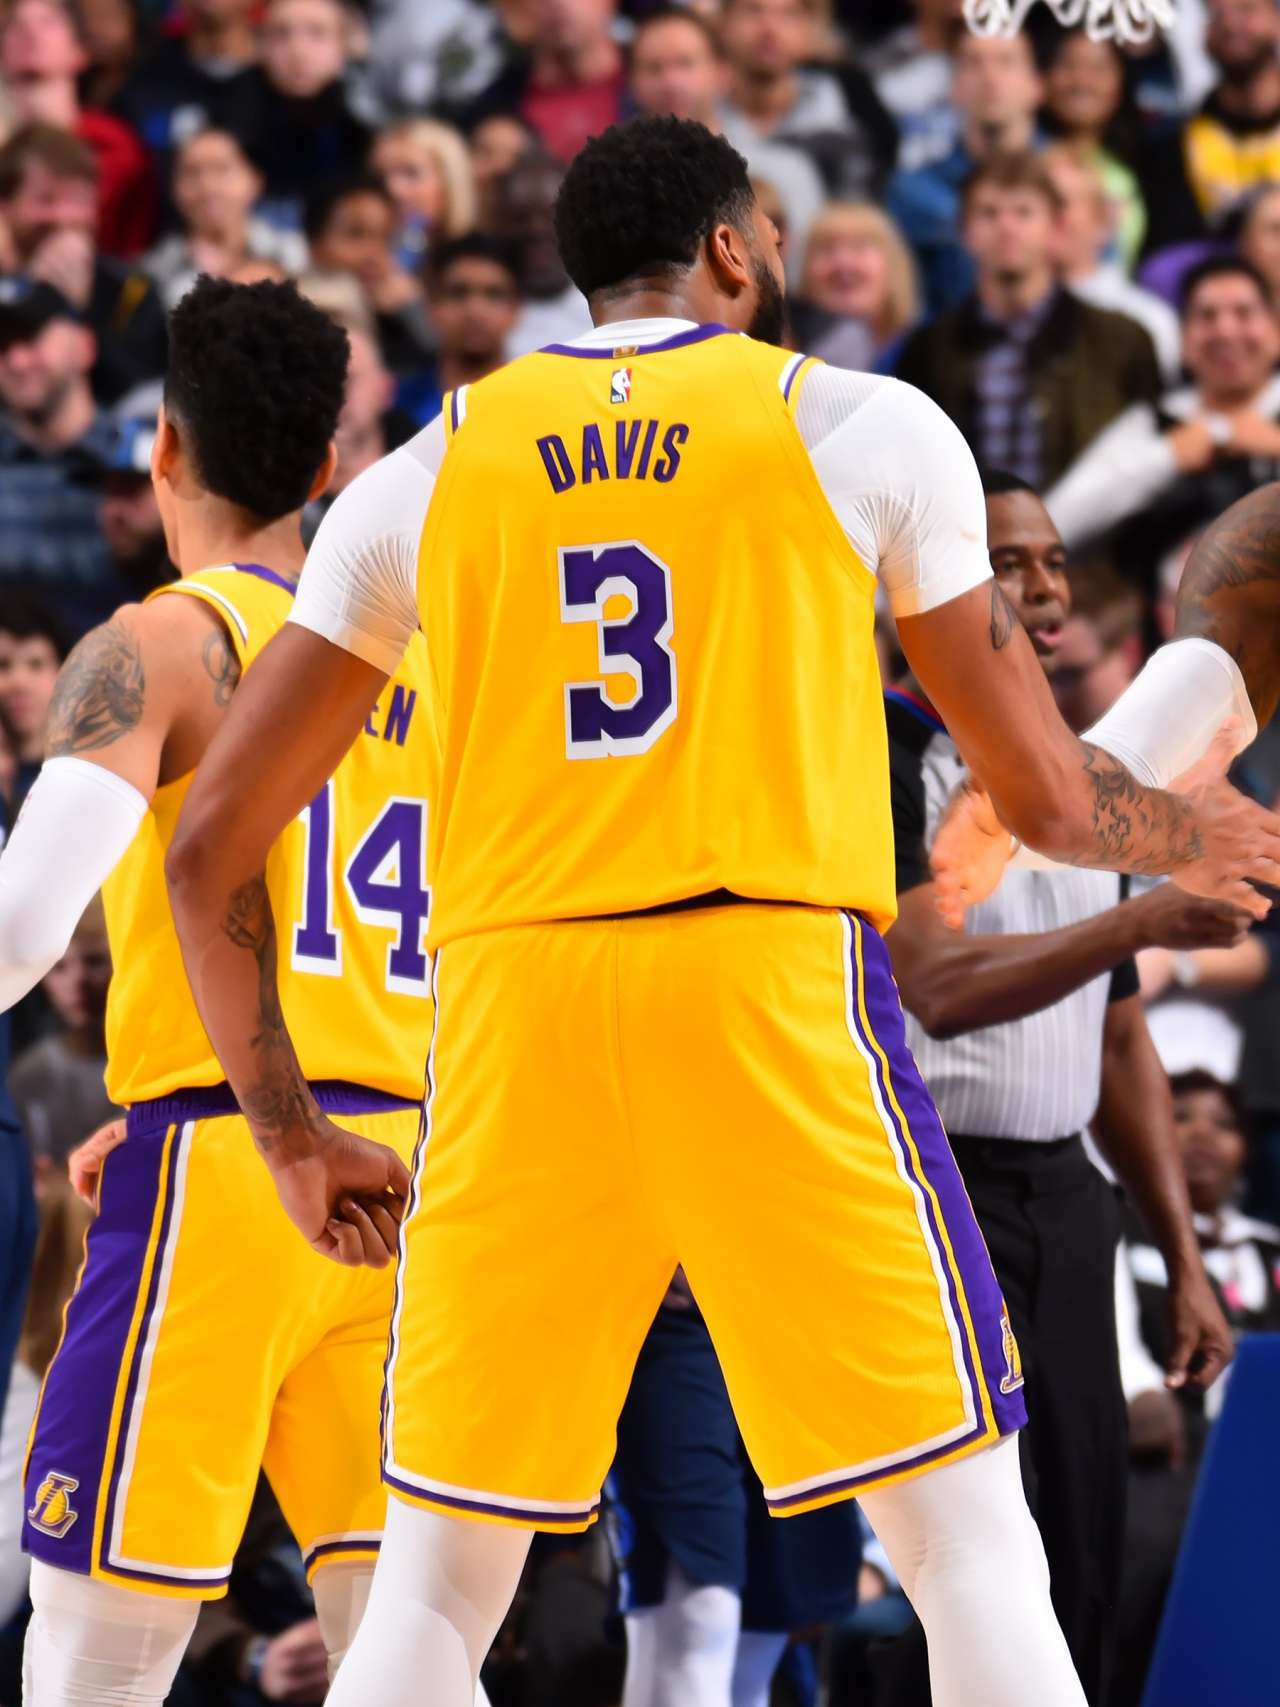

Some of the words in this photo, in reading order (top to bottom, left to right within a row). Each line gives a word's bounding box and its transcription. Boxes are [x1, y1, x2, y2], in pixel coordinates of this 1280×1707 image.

[536, 419, 690, 494] DAVIS
[557, 539, 678, 760] 3
[291, 778, 433, 998] 14
